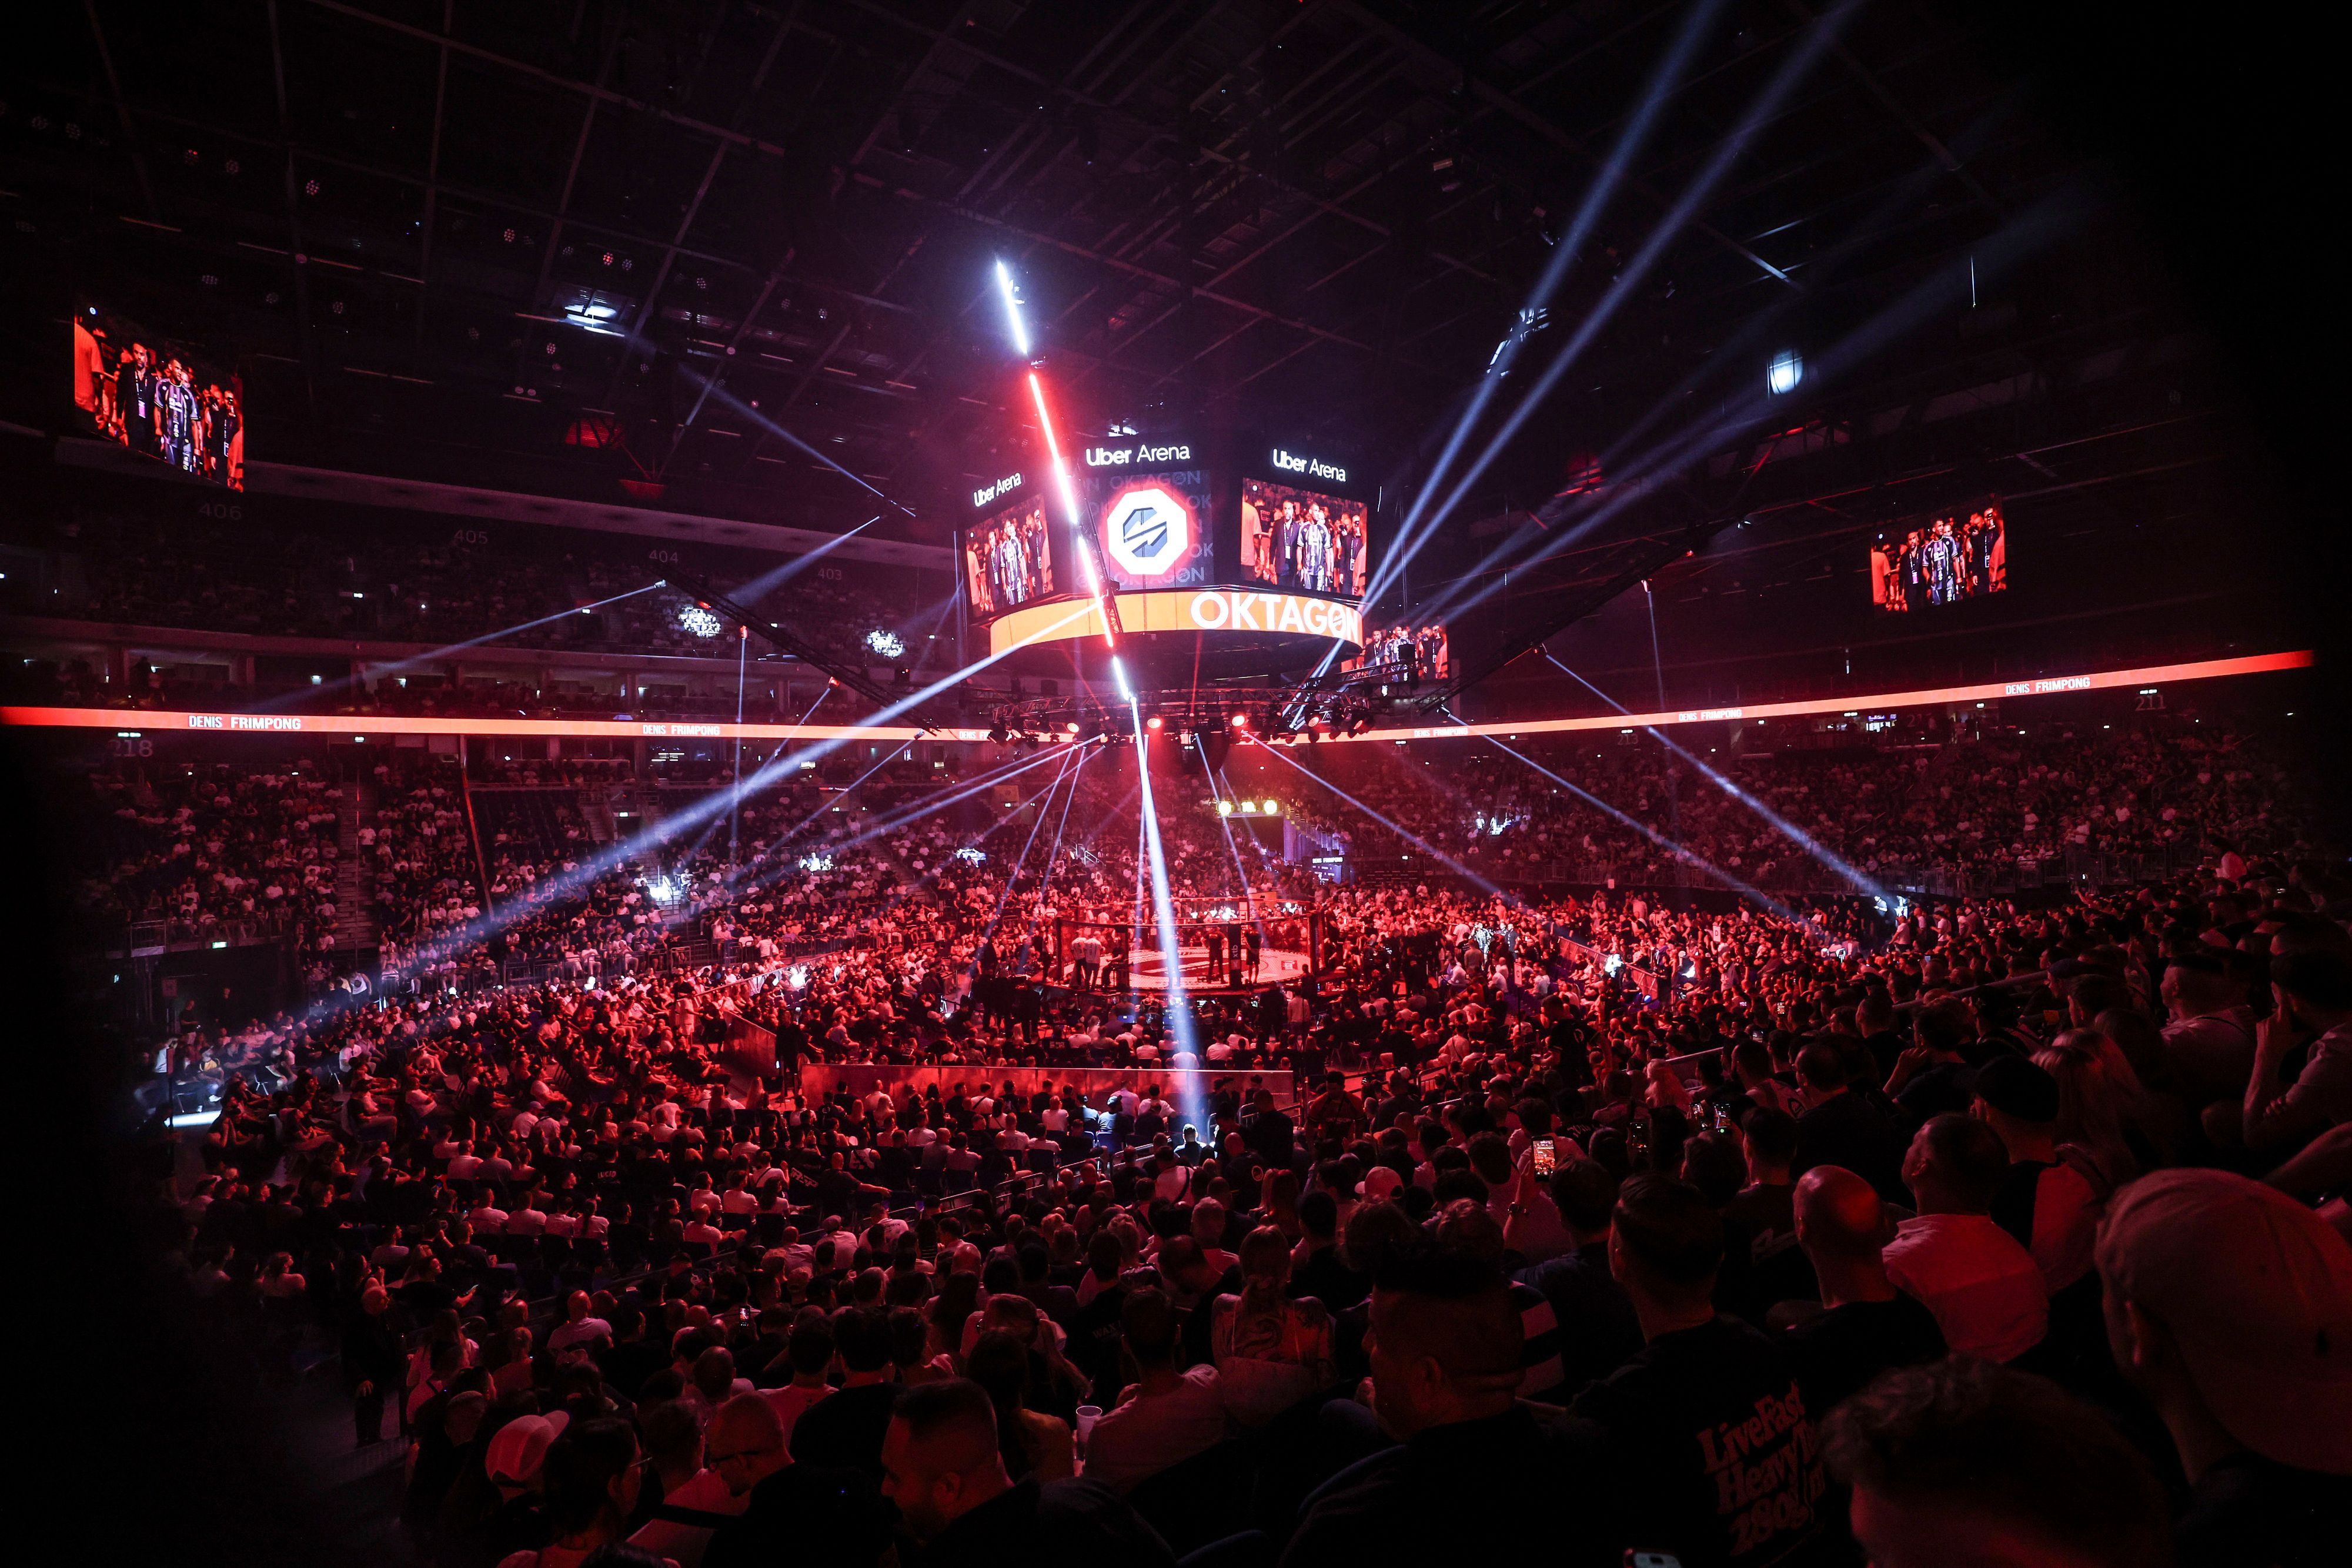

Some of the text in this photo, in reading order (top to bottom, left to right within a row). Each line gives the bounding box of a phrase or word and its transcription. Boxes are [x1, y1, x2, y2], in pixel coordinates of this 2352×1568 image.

[1085, 444, 1191, 466] Uber Arena
[1272, 449, 1346, 482] Uber Arena
[973, 472, 1022, 507] Uber Arena
[199, 503, 242, 520] 406
[453, 529, 489, 544] 405
[649, 550, 679, 563] 404
[817, 568, 842, 581] 403
[1191, 591, 1359, 643] OKTAGON
[2006, 677, 2090, 694] DENIS FRIMPONG
[2134, 694, 2167, 711] 211
[189, 716, 301, 730] DENIS FRIMPONG
[1679, 709, 1742, 722] DENIS FRIMPONG
[643, 725, 720, 735] DENIS FRIMPONG
[959, 731, 977, 739] DENIS
[1433, 728, 1468, 736] FRIMPONG
[1616, 733, 1638, 745] 213
[106, 739, 153, 757] 218
